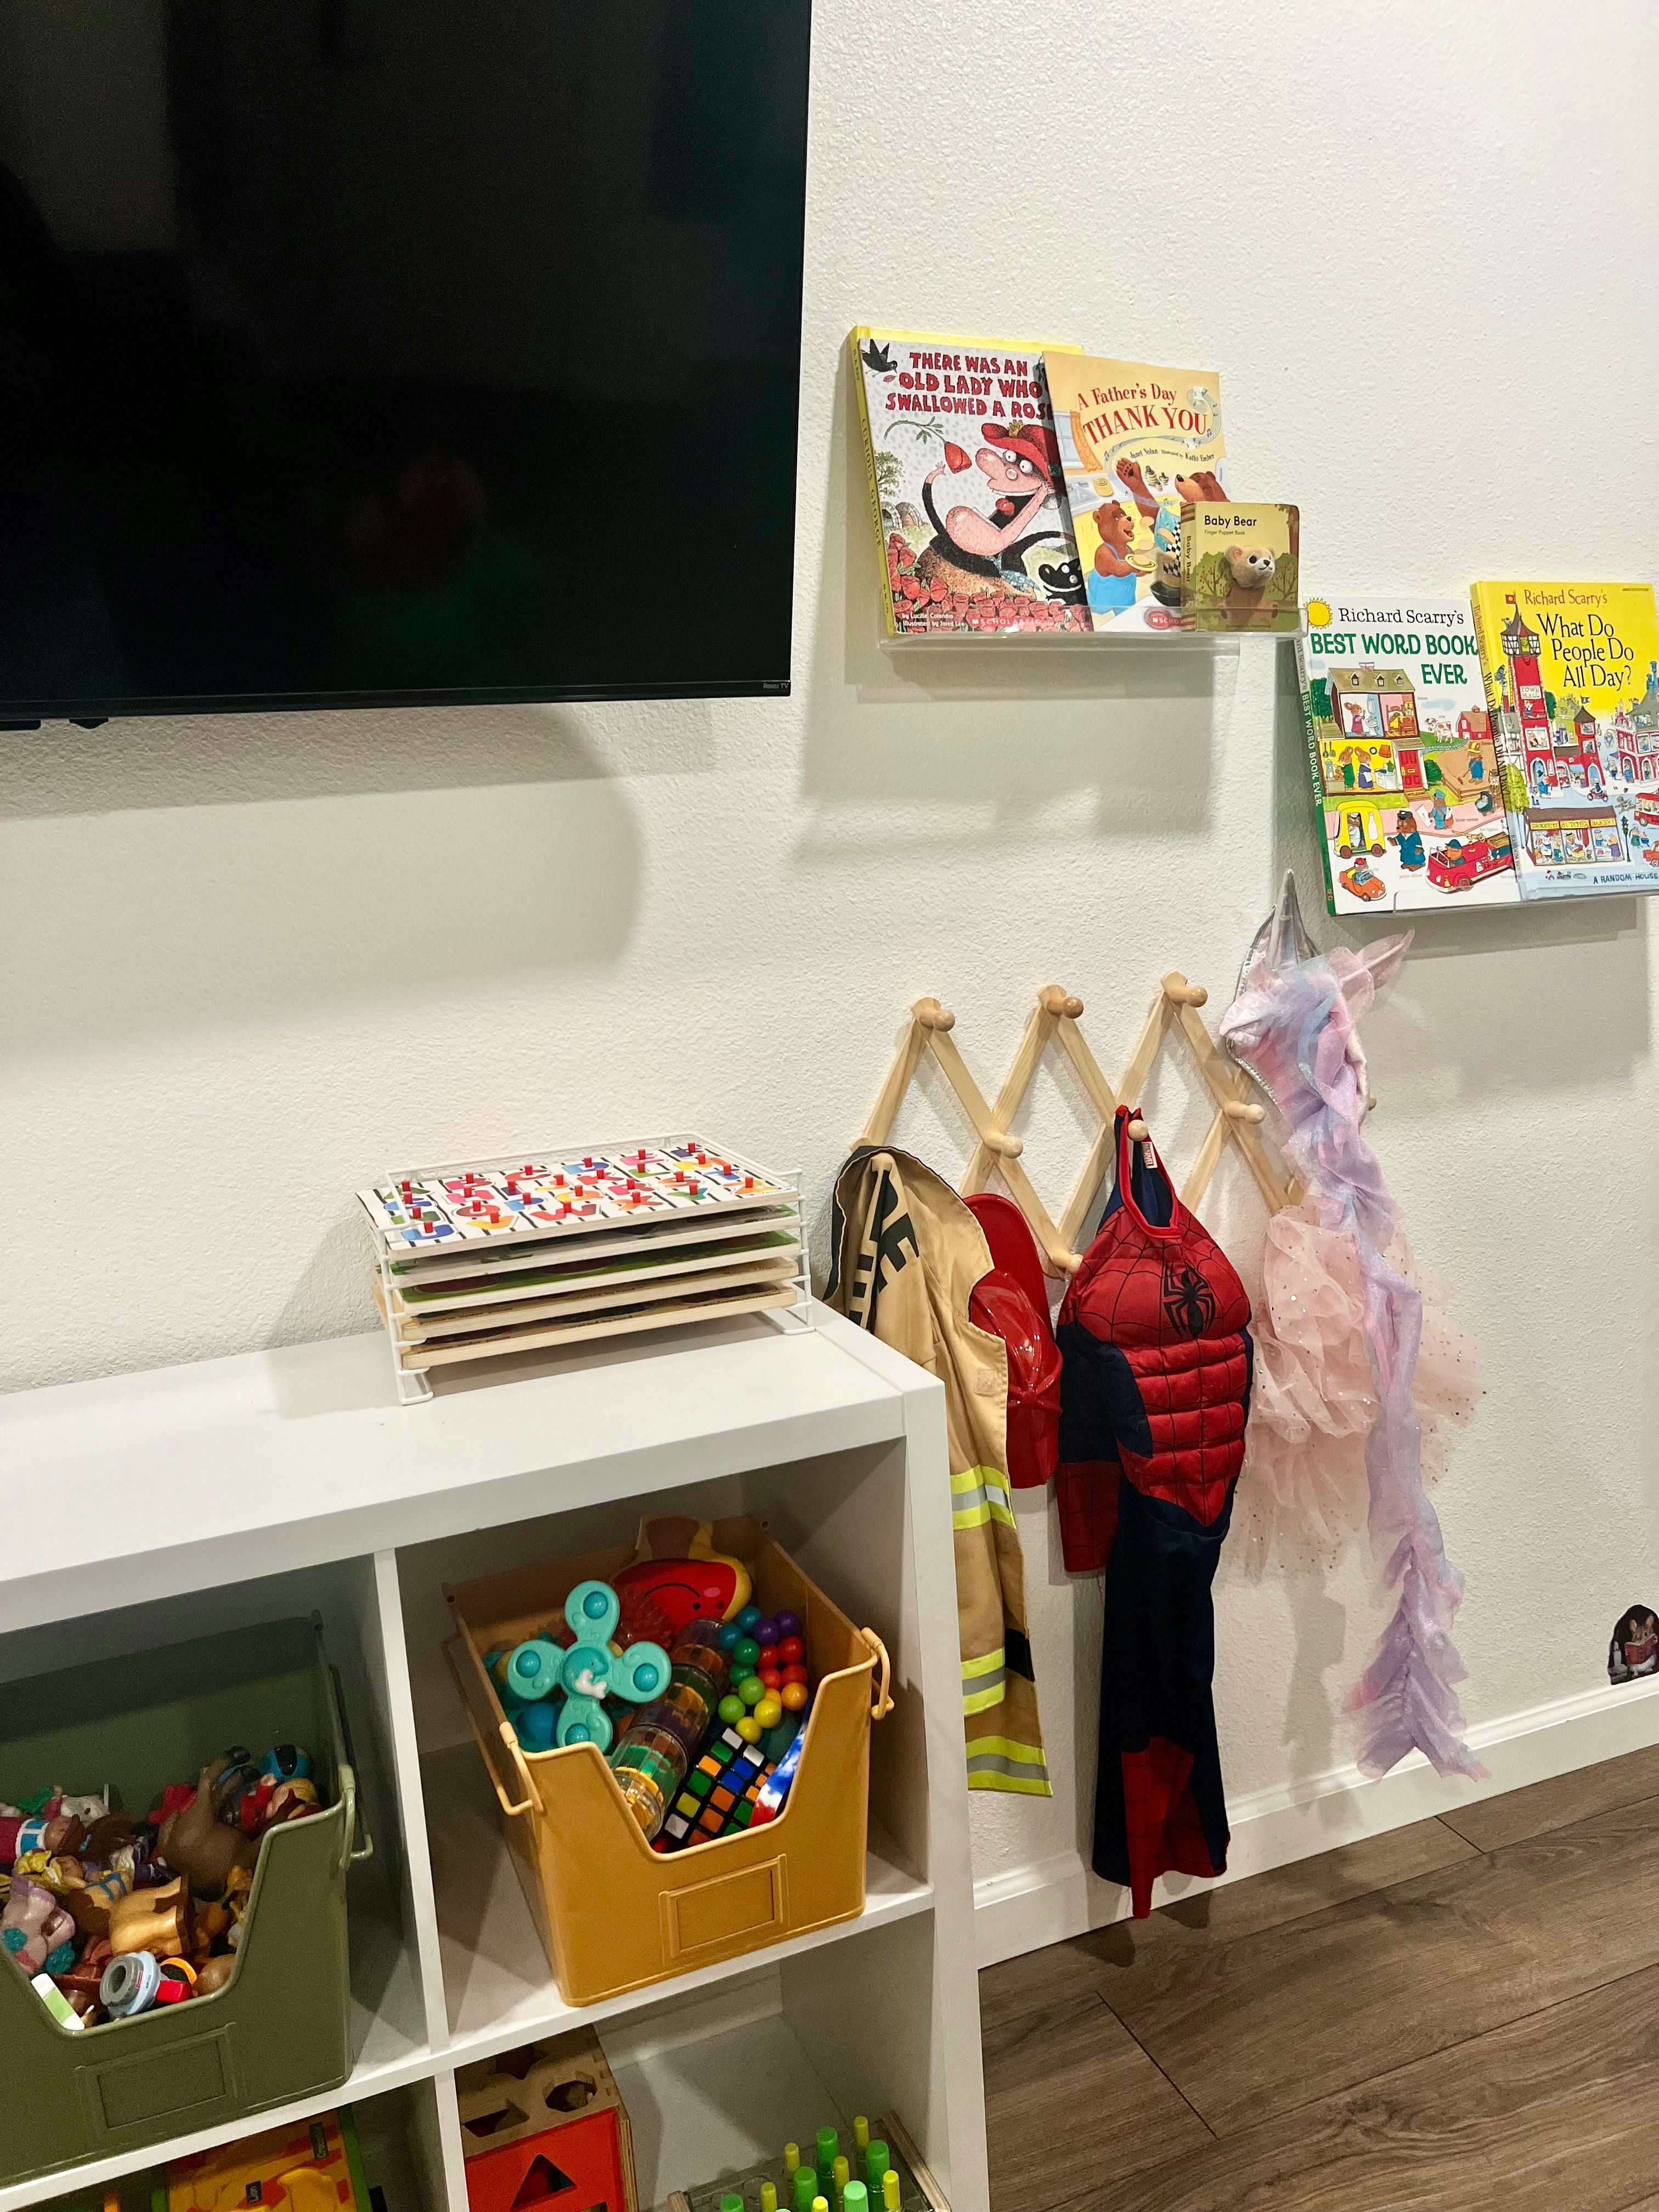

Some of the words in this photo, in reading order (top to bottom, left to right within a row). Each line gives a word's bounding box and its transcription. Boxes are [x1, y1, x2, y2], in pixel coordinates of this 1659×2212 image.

[909, 352, 961, 371] THERE
[965, 355, 1001, 374] WAS
[1004, 359, 1028, 377] AN
[899, 372, 939, 392] OLD
[944, 375, 993, 396] LADY
[997, 379, 1042, 399] WHO
[1077, 393, 1090, 410] A
[1090, 382, 1147, 407] Father's
[1150, 383, 1178, 406] Day
[885, 392, 987, 416] SWALLOWED
[992, 400, 1005, 417] A
[1082, 405, 1160, 445] THANK
[1161, 407, 1208, 436] YOU
[861, 418, 873, 481] CURIOUS
[1130, 450, 1143, 459] Janet
[1184, 453, 1199, 462] Kathi
[1199, 453, 1215, 462] Ember
[1204, 515, 1231, 529] Baby
[1233, 515, 1257, 527] Bear
[1523, 589, 1565, 605] Richard
[1568, 589, 1607, 608] Scarry's
[980, 618, 1041, 626] SCHOLASTIC
[1338, 608, 1403, 623] Richard
[1407, 609, 1464, 627] Scarry's
[1536, 613, 1584, 637] What
[1587, 614, 1614, 637] Do
[1310, 633, 1356, 654] BEST
[1361, 633, 1421, 654] WORD
[1425, 634, 1479, 656] BOOK
[1473, 605, 1484, 635] Richard
[1479, 635, 1489, 666] Scarry's
[1551, 638, 1606, 668] People
[1607, 637, 1634, 661] Do
[1298, 654, 1308, 691] Scarry's
[1421, 663, 1468, 684] EVER
[1483, 671, 1494, 698] What
[1563, 665, 1585, 688] All
[1589, 664, 1632, 692] Day?
[1302, 693, 1312, 717] BEST
[1487, 698, 1496, 712] Do
[1305, 719, 1315, 749] WORD
[1495, 743, 1504, 758] Do
[1309, 750, 1320, 781] BOOK
[1313, 782, 1322, 807] EVER
[1510, 834, 1519, 860] RANDOM
[1593, 876, 1598, 884] A
[1601, 874, 1632, 883] RANDOM
[1635, 872, 1658, 881] HOUSE
[444, 1178, 492, 1190] B
[505, 1169, 552, 1181] C
[562, 1162, 610, 1175] D
[619, 1153, 665, 1166] E
[445, 1190, 495, 1204] H
[577, 1172, 624, 1185] K
[673, 1158, 726, 1171] M
[456, 1204, 500, 1217] O
[504, 1198, 544, 1211] P
[556, 1190, 605, 1202] Q
[607, 1182, 655, 1195] R
[658, 1176, 701, 1188] S
[401, 1224, 455, 1241] U
[467, 1216, 515, 1230] V
[529, 1204, 597, 1221] W
[613, 1195, 664, 1211] X
[667, 1188, 708, 1200] Y
[722, 1180, 778, 1194] Z
